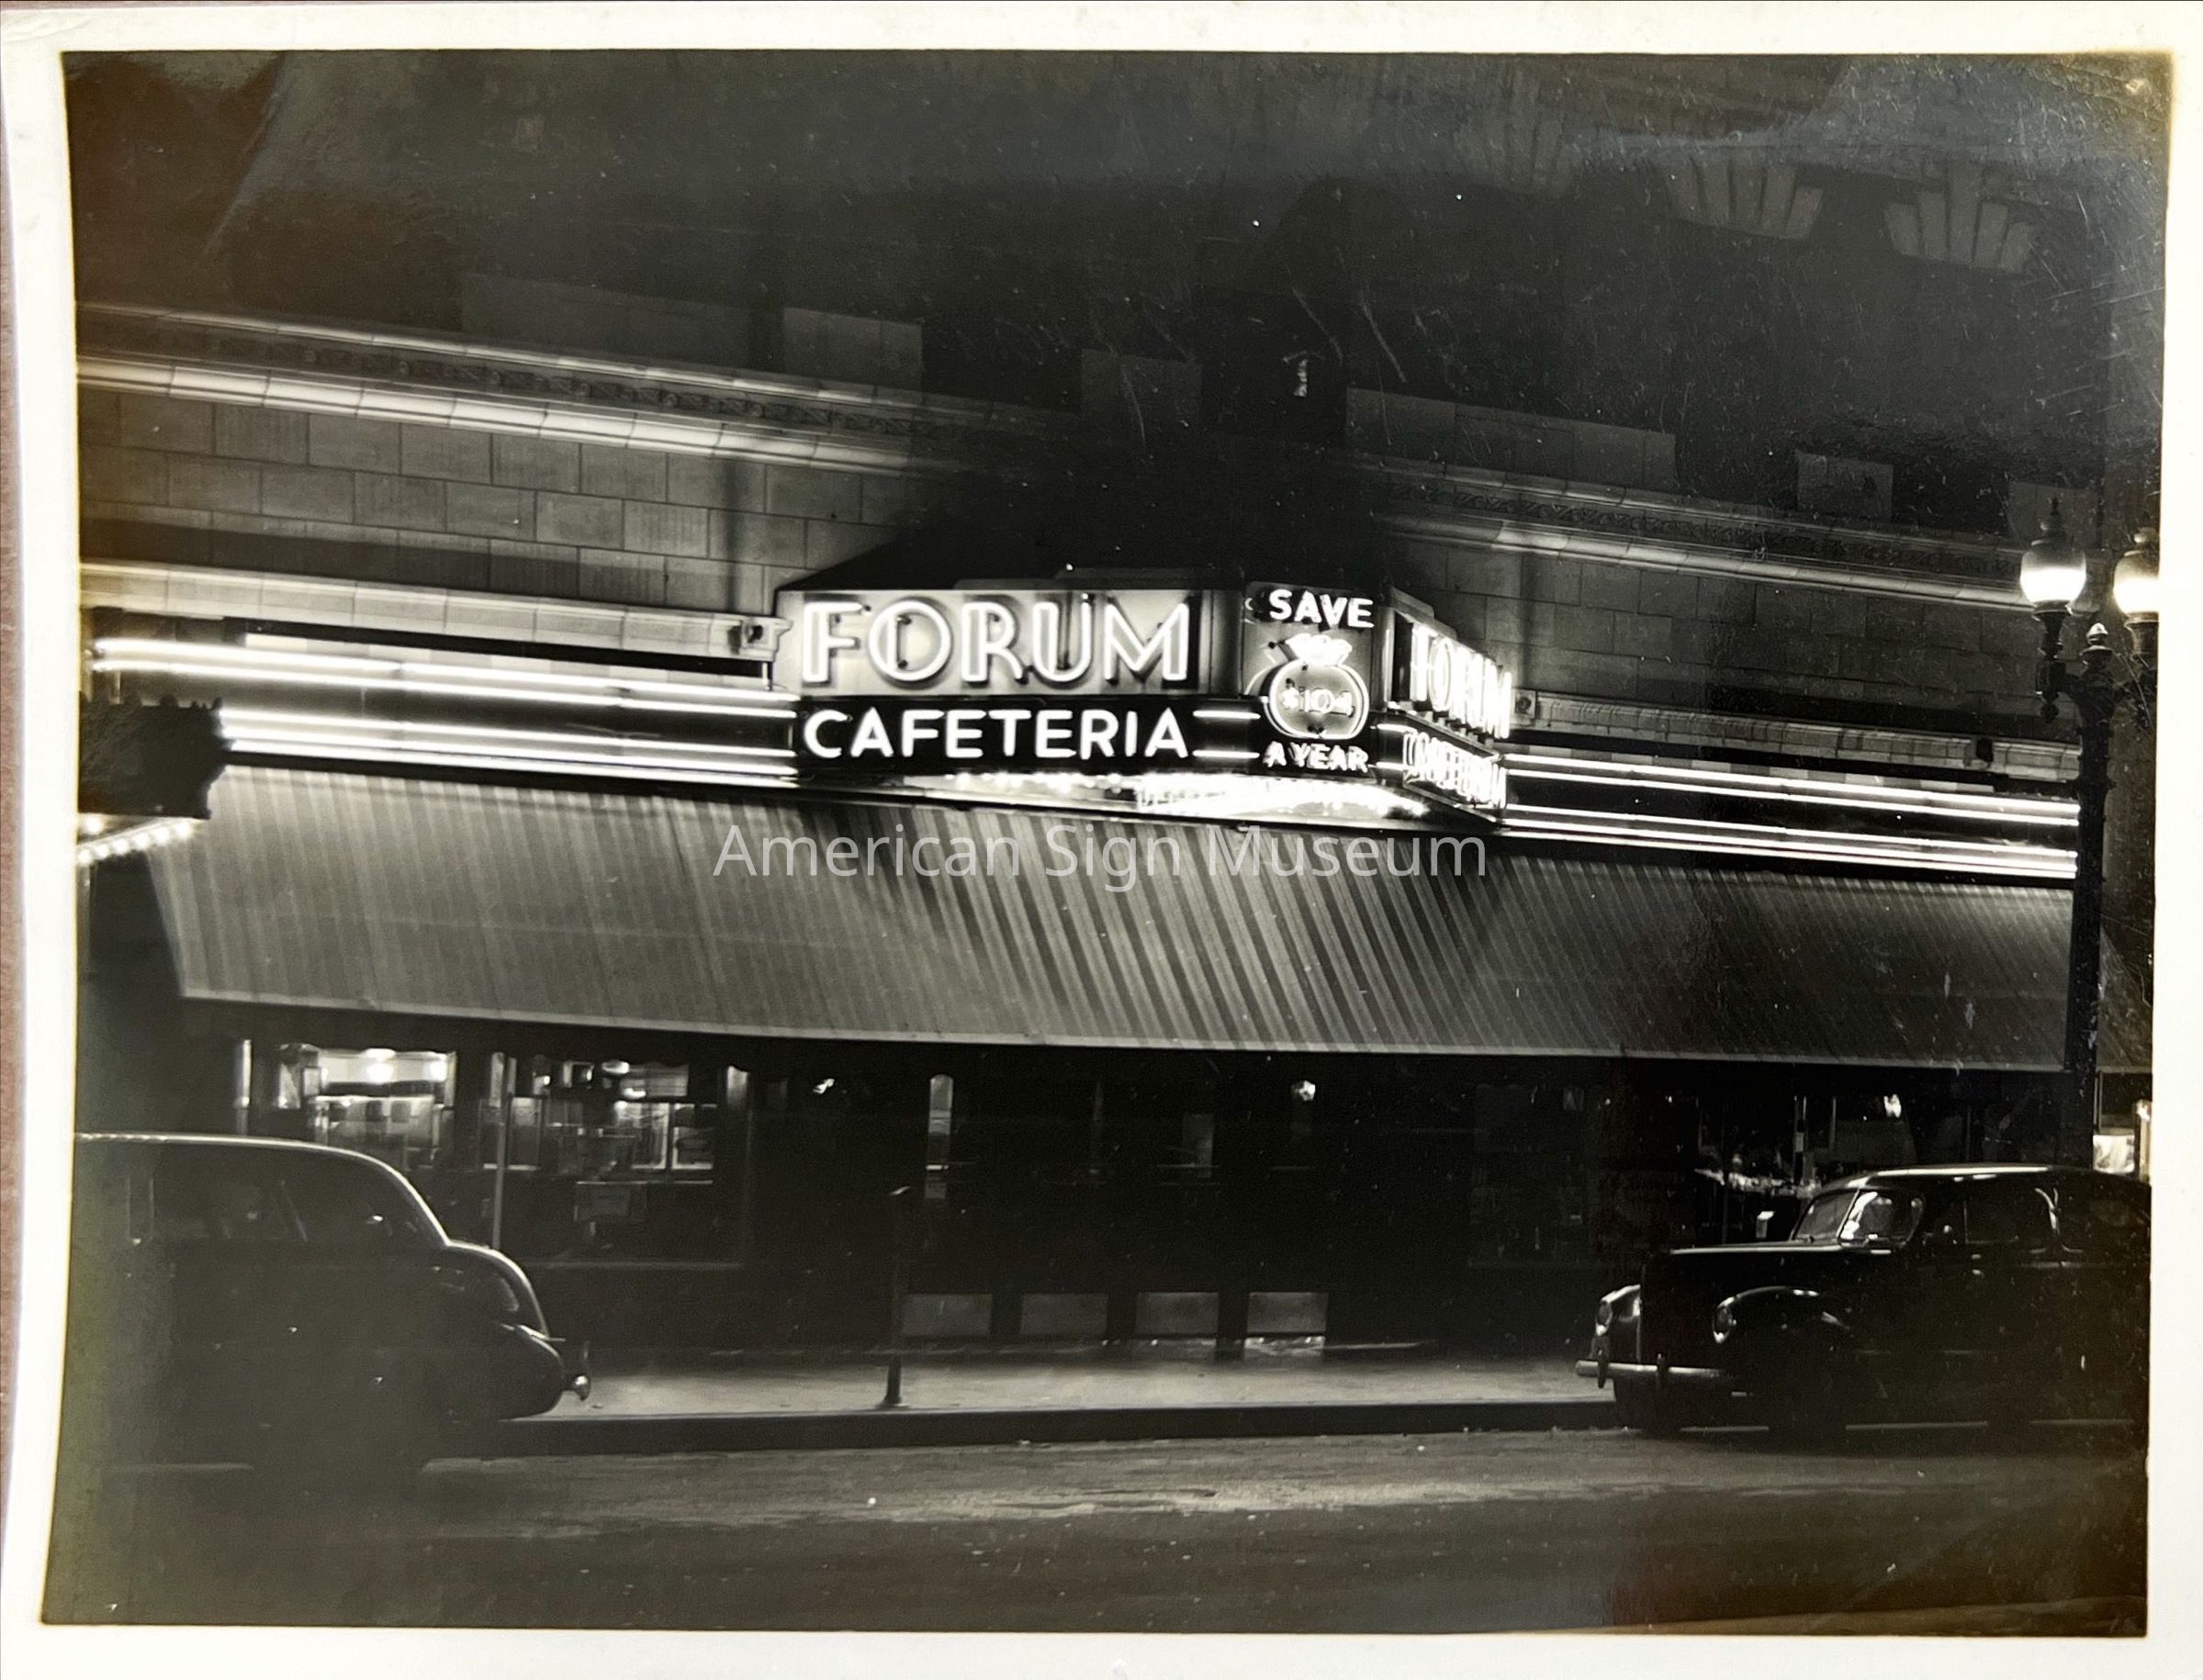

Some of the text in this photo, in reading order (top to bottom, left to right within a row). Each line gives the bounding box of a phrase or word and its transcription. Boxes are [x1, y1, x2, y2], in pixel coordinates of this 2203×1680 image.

[1269, 588, 1374, 628] SAVE
[802, 599, 1191, 682] FORUM
[803, 705, 1189, 760] CAFETERIA
[1264, 741, 1369, 773] A YEAR
